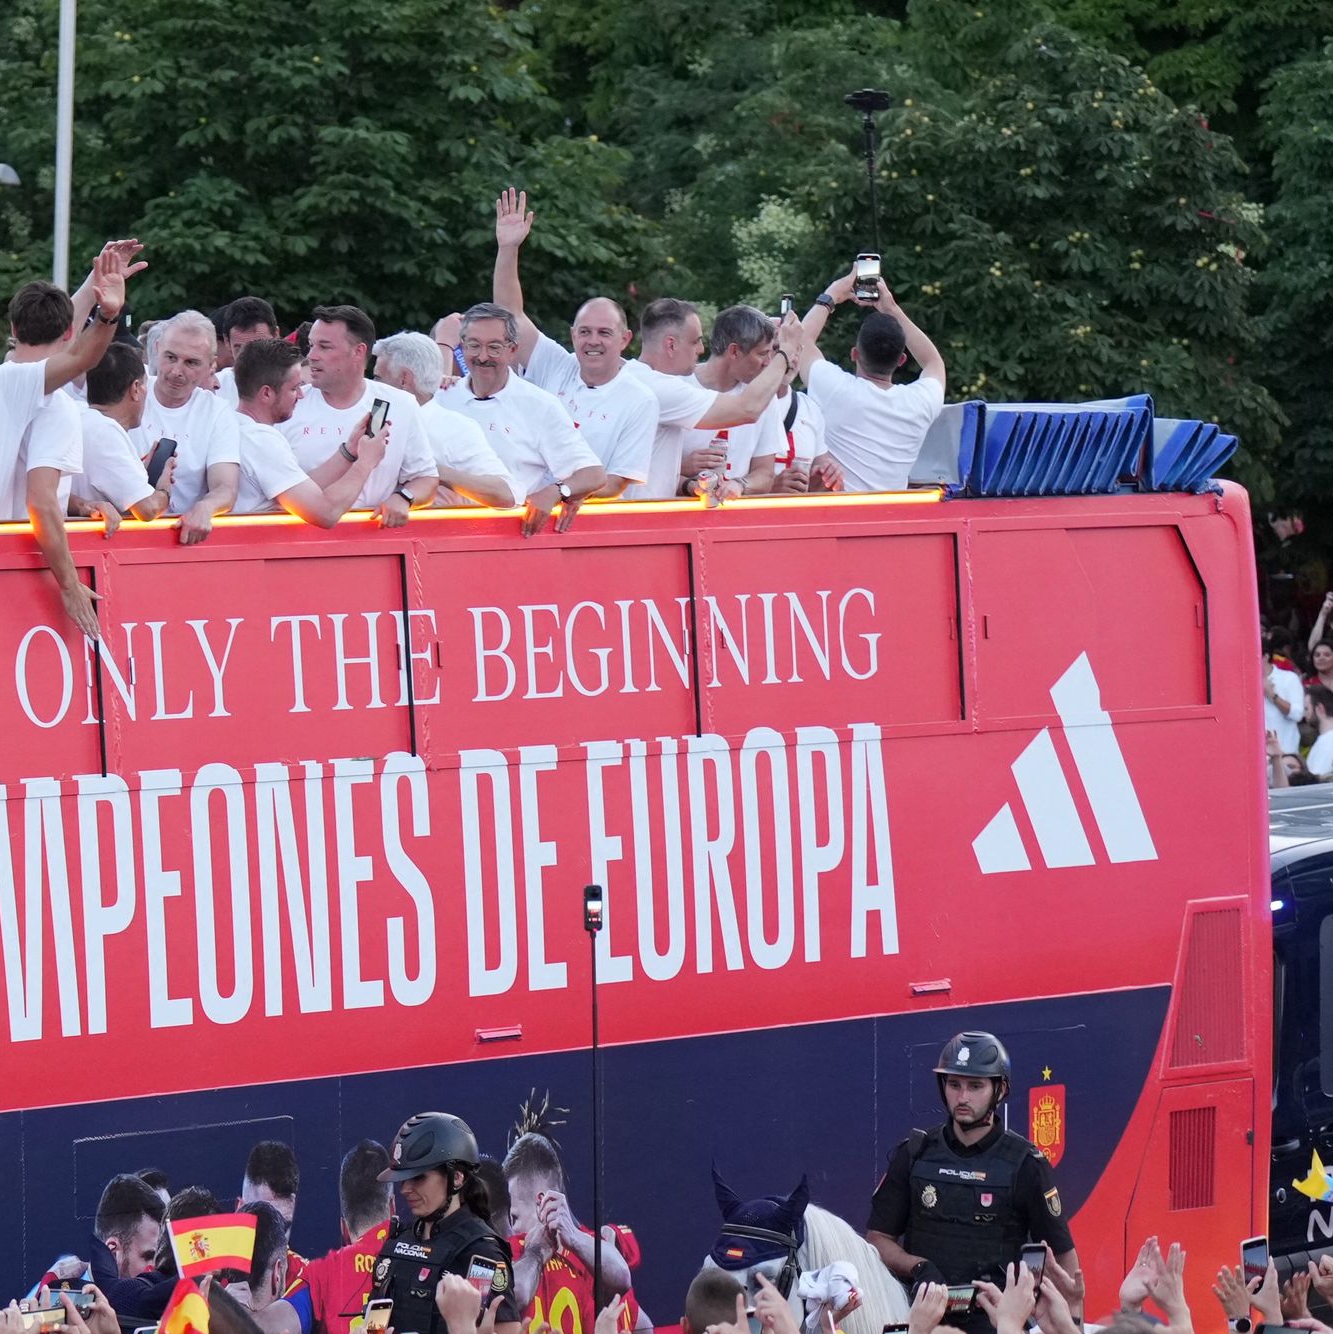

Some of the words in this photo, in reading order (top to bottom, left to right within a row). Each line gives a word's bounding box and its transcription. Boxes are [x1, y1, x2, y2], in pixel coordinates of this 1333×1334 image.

[14, 616, 245, 729] ONLY
[269, 609, 440, 713] THE
[466, 586, 882, 703] BEGINNING
[457, 744, 568, 998] DE
[579, 721, 900, 985] EUROPA
